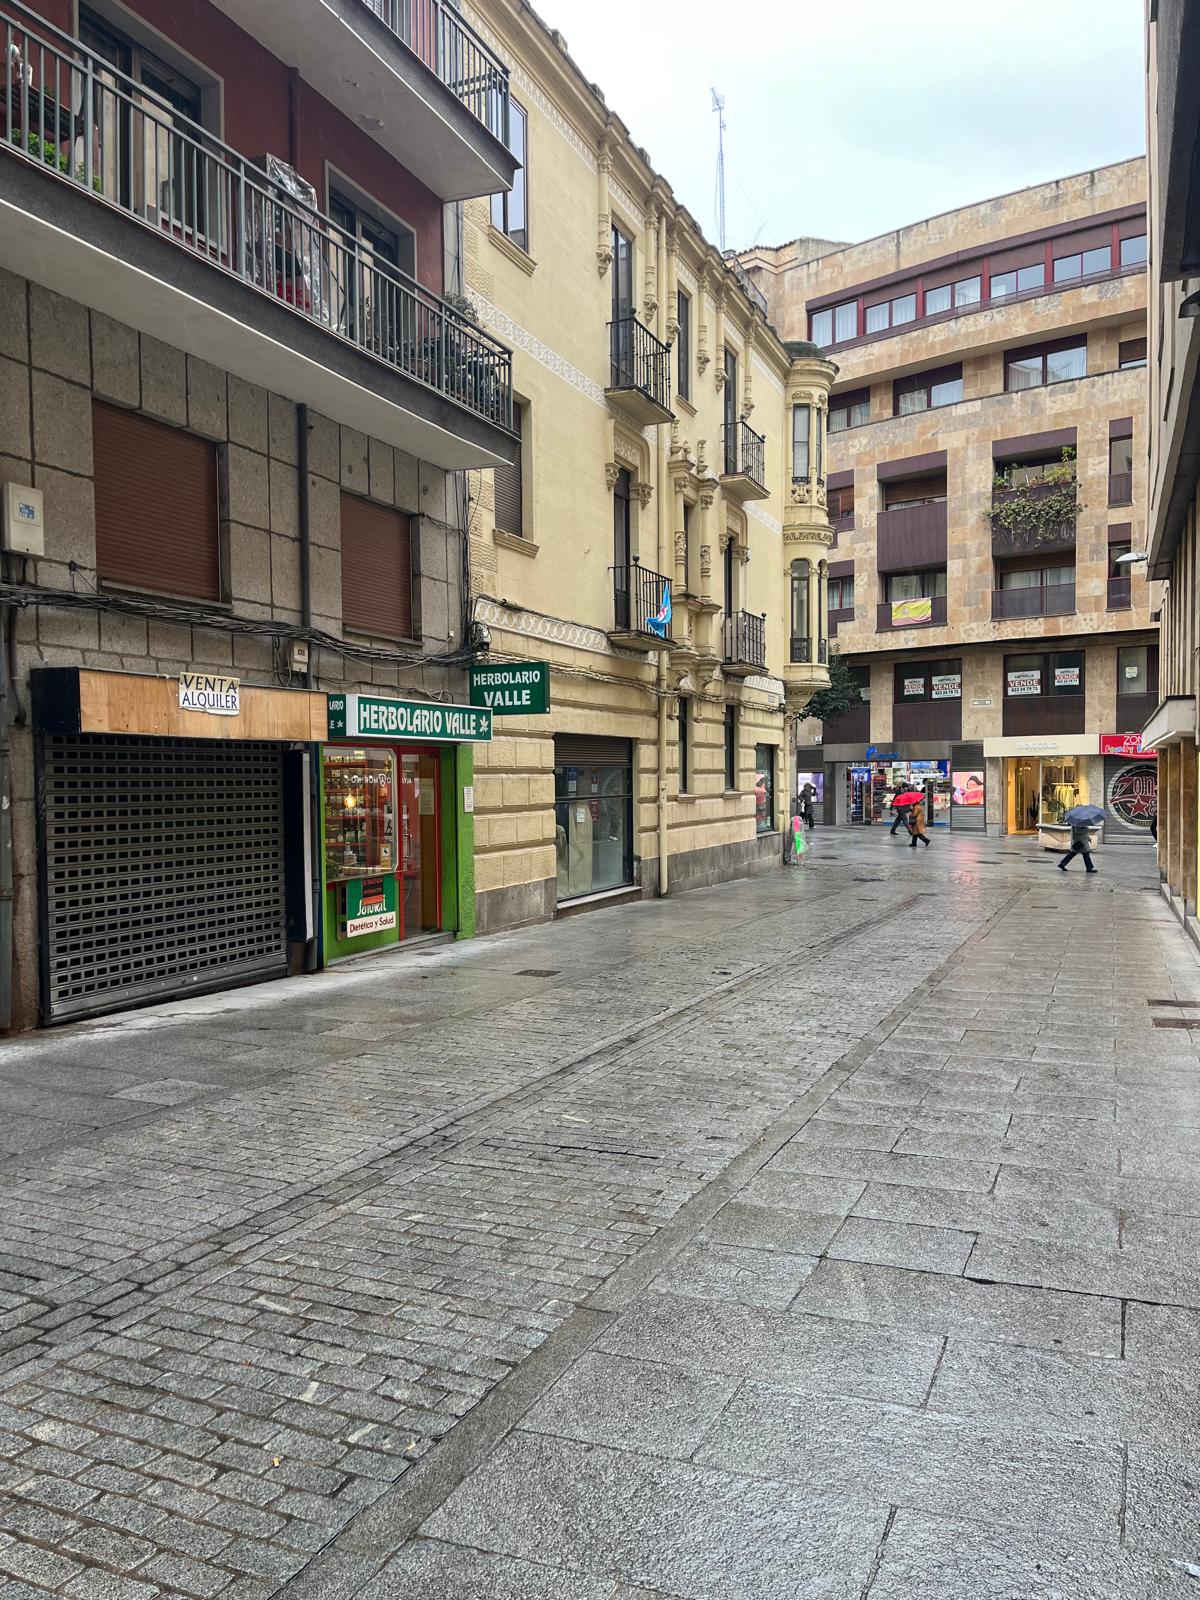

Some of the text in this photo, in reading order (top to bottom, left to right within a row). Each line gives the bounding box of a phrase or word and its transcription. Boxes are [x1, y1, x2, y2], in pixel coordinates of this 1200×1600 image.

[182, 674, 237, 694] VENTA
[473, 670, 541, 687] HERBOLARIO
[182, 691, 237, 710] ALQUILER
[483, 689, 531, 707] VALLE
[359, 703, 477, 737] HERBOLARIO VALLE
[349, 916, 394, 933] Dietética y Salud
